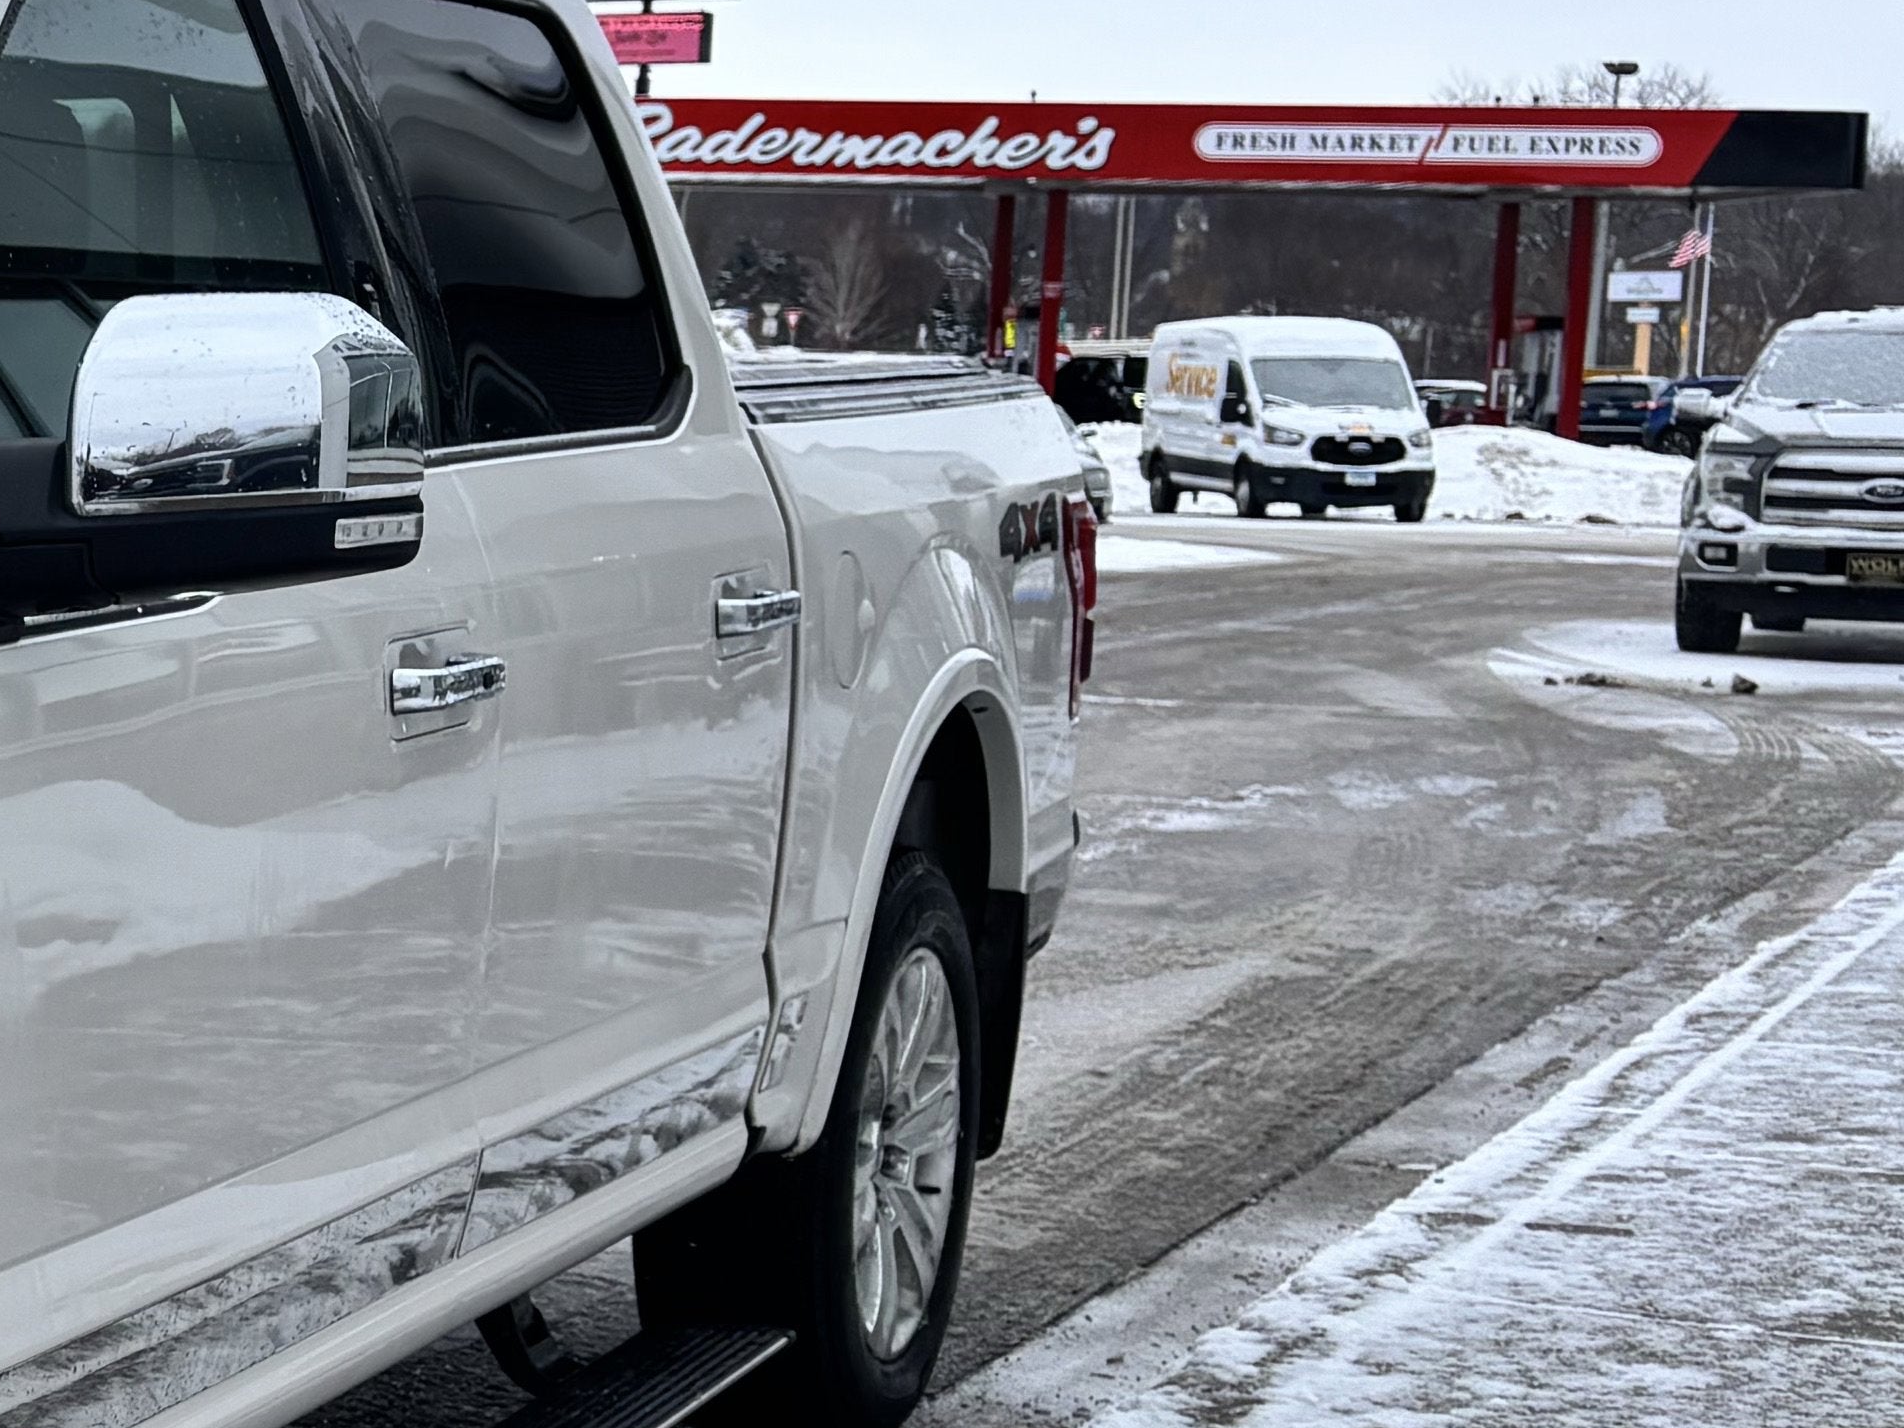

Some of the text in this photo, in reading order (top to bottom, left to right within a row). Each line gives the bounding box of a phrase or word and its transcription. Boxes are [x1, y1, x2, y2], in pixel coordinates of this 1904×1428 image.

[638, 102, 1116, 170] Radermacher's
[1215, 131, 1642, 156] FRESH MARKET FUEL EXPRESS
[1166, 352, 1218, 399] Service
